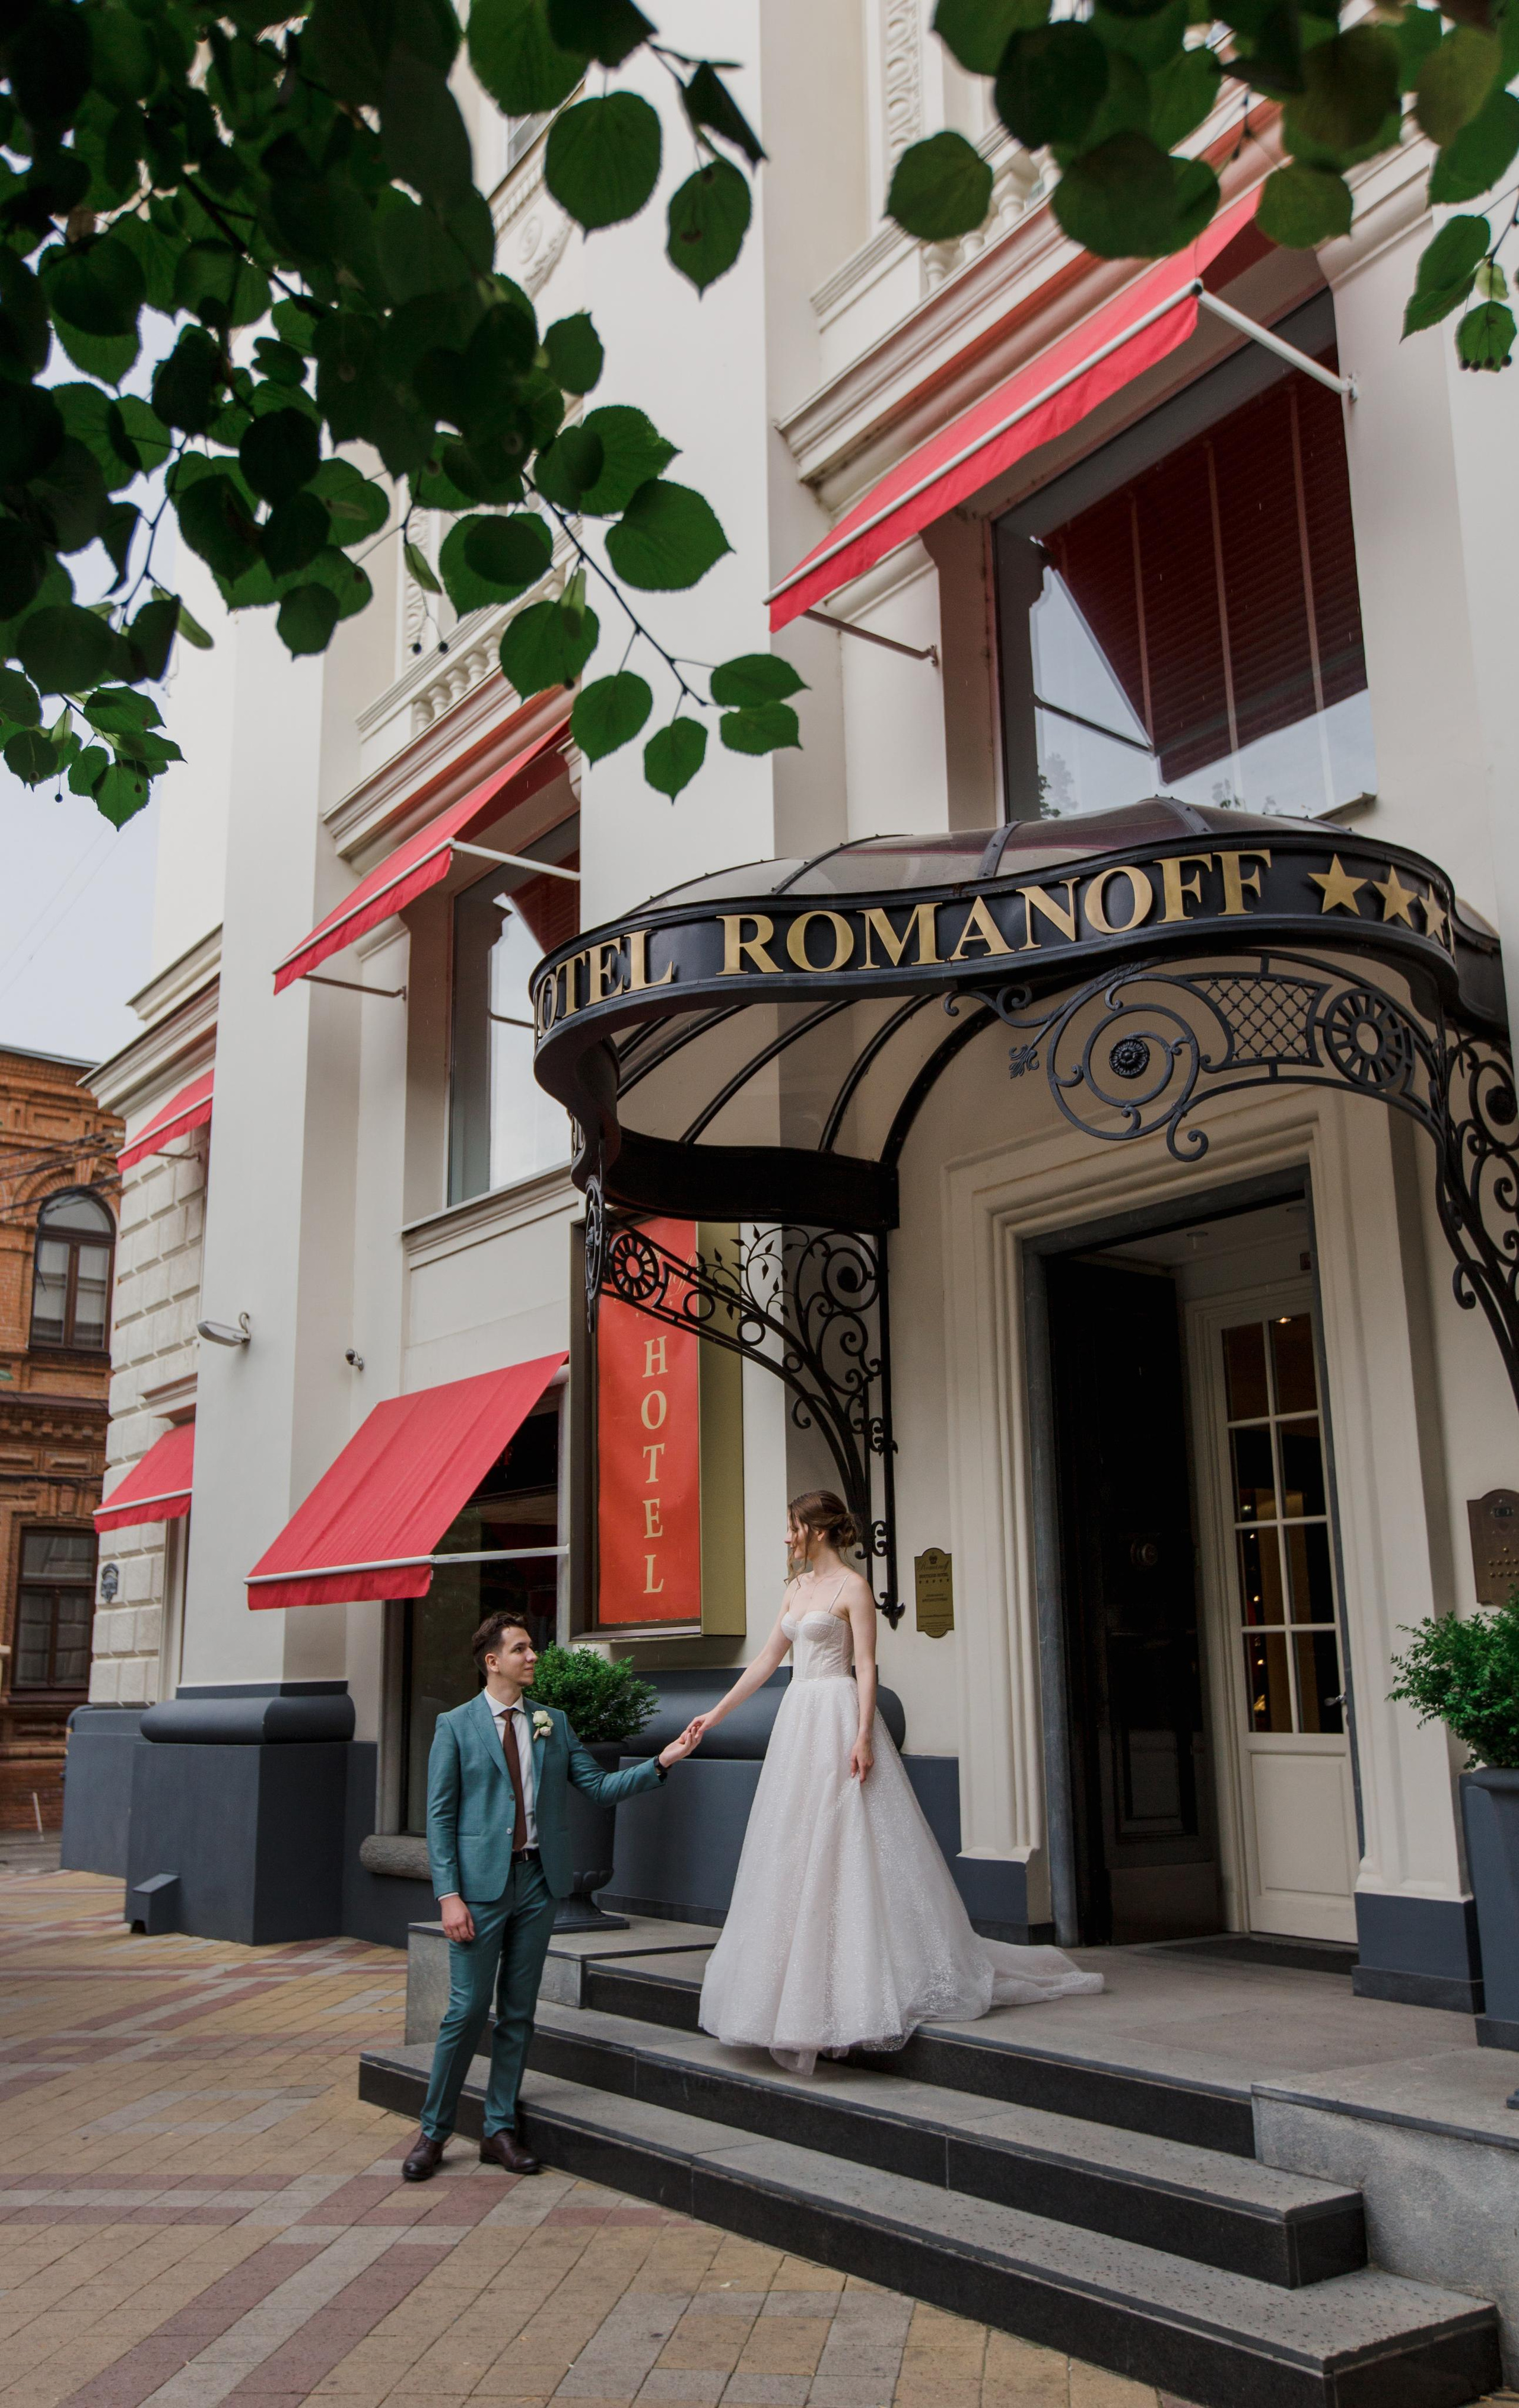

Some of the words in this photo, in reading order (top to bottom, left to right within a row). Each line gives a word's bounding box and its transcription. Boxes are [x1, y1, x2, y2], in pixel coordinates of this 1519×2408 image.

[535, 929, 673, 1048] OTEL
[716, 849, 1272, 975] ROMANOFF
[641, 1335, 668, 1593] HOTEL
